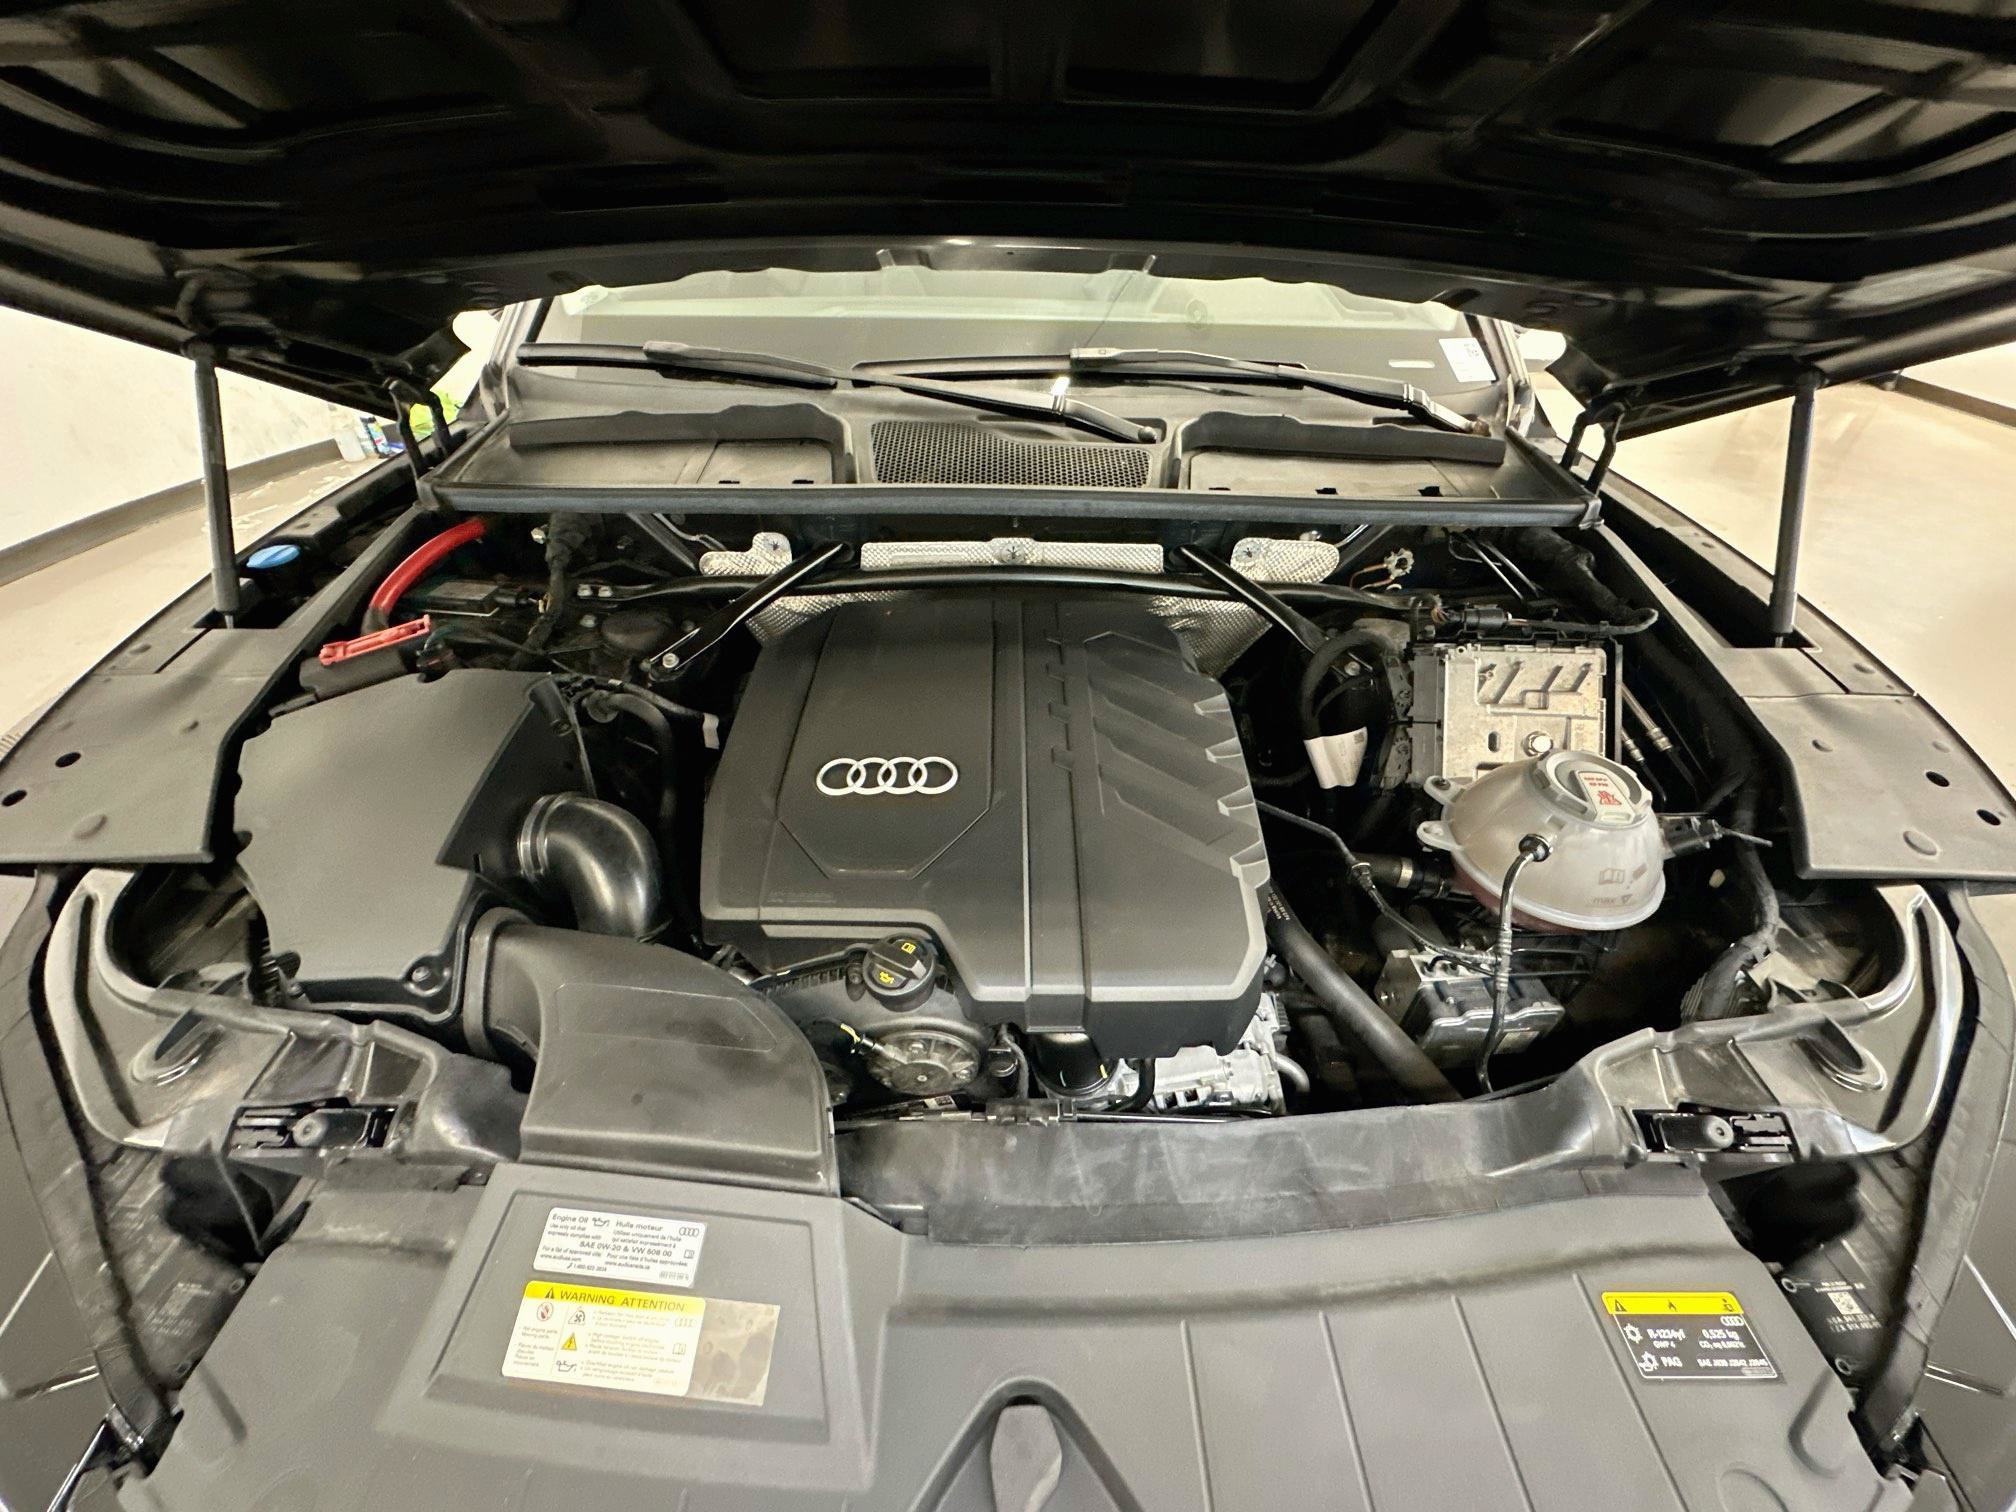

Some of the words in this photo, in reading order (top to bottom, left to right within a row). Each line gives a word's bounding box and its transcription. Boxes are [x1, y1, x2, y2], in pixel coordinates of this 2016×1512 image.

[552, 1213, 576, 1223] Engine
[615, 1220, 634, 1229] Huile
[635, 1223, 663, 1231] moteur
[579, 1241, 595, 1249] SAE
[597, 1243, 622, 1251] 0W-20
[632, 1246, 646, 1254] VW
[560, 1290, 616, 1305] WARNING
[619, 1297, 686, 1312] ATTENTION
[1661, 1357, 1683, 1367] PAG
